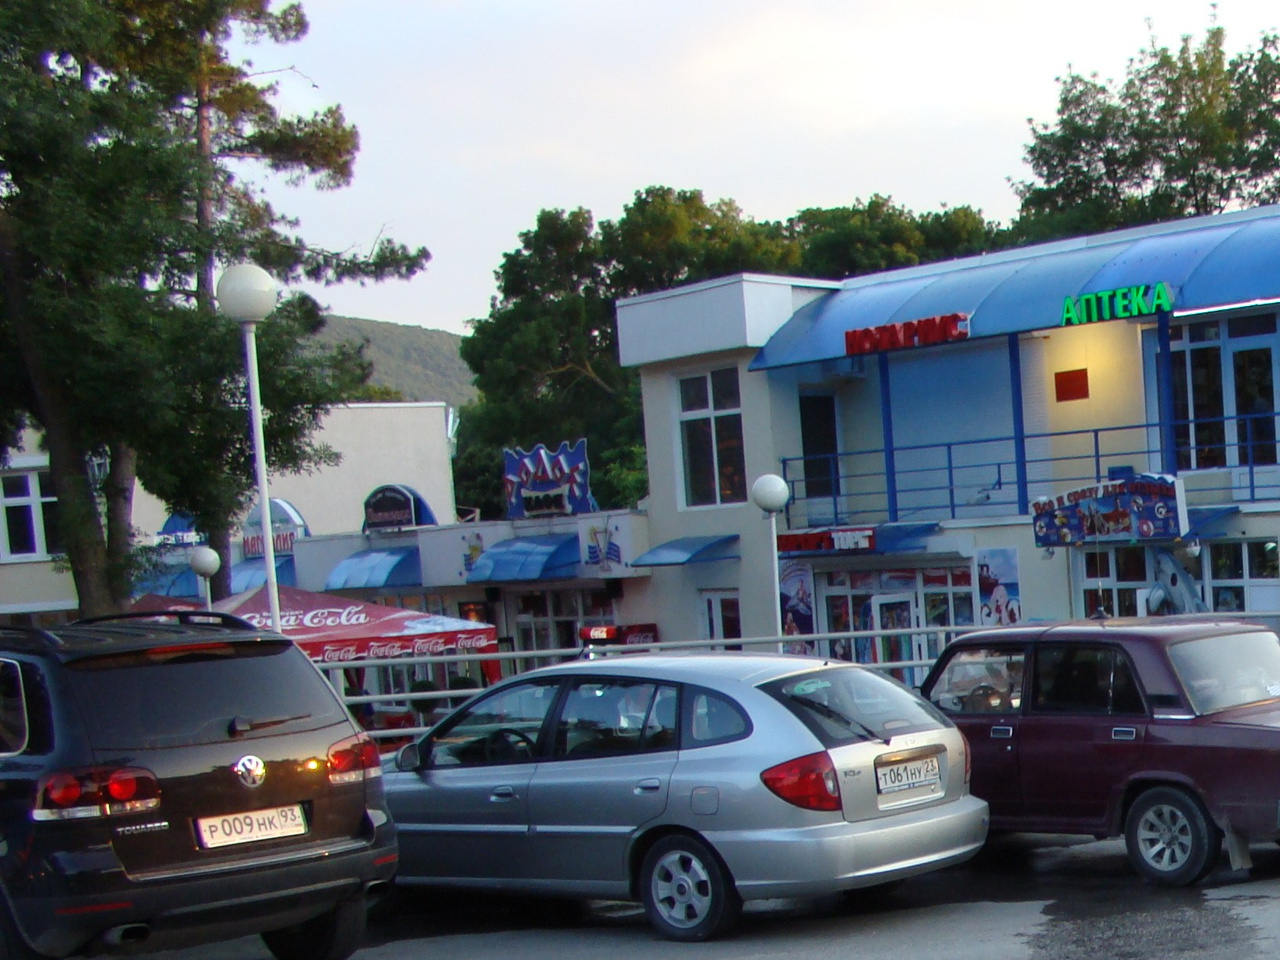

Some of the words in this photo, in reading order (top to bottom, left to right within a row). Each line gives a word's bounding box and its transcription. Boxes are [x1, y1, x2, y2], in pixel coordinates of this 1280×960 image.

[1062, 283, 1172, 326] АПТЕКА
[924, 759, 936, 774] 23
[281, 807, 297, 823] 93
[116, 821, 170, 836] TOUAREG
